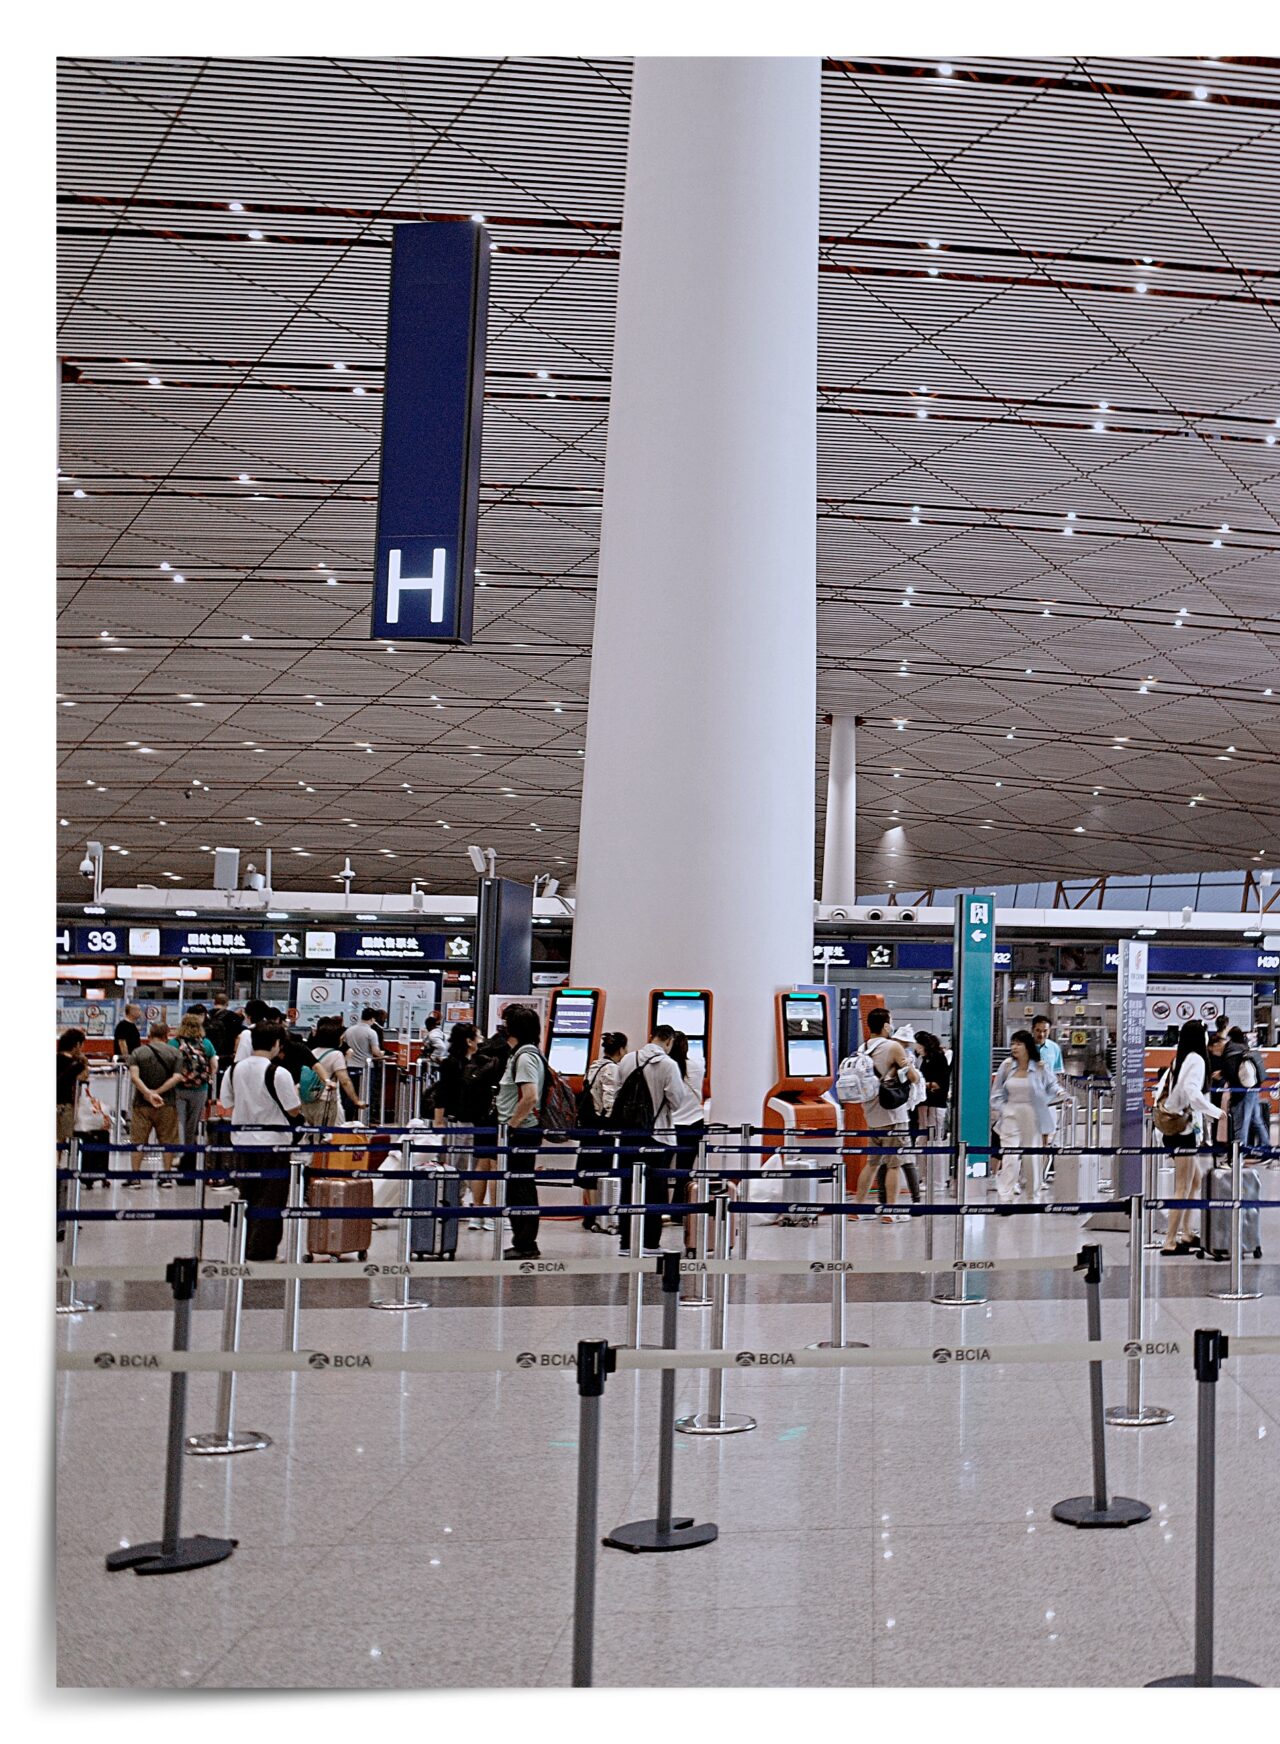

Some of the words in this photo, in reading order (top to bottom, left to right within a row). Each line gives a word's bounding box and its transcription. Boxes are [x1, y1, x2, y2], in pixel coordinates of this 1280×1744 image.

[387, 548, 446, 623] H
[87, 931, 117, 951] 33
[222, 1266, 251, 1276] BCIA
[383, 1265, 411, 1274] BCIA
[538, 1263, 565, 1271] BCIA
[680, 1262, 707, 1271] BCIA
[827, 1263, 853, 1271] BCIA
[955, 1349, 990, 1361] BCIA
[1145, 1343, 1180, 1355] BCIA
[119, 1355, 159, 1368] BCIA
[333, 1355, 372, 1368] BCIA
[541, 1354, 577, 1366] BCIA
[760, 1353, 796, 1366] BCIA
